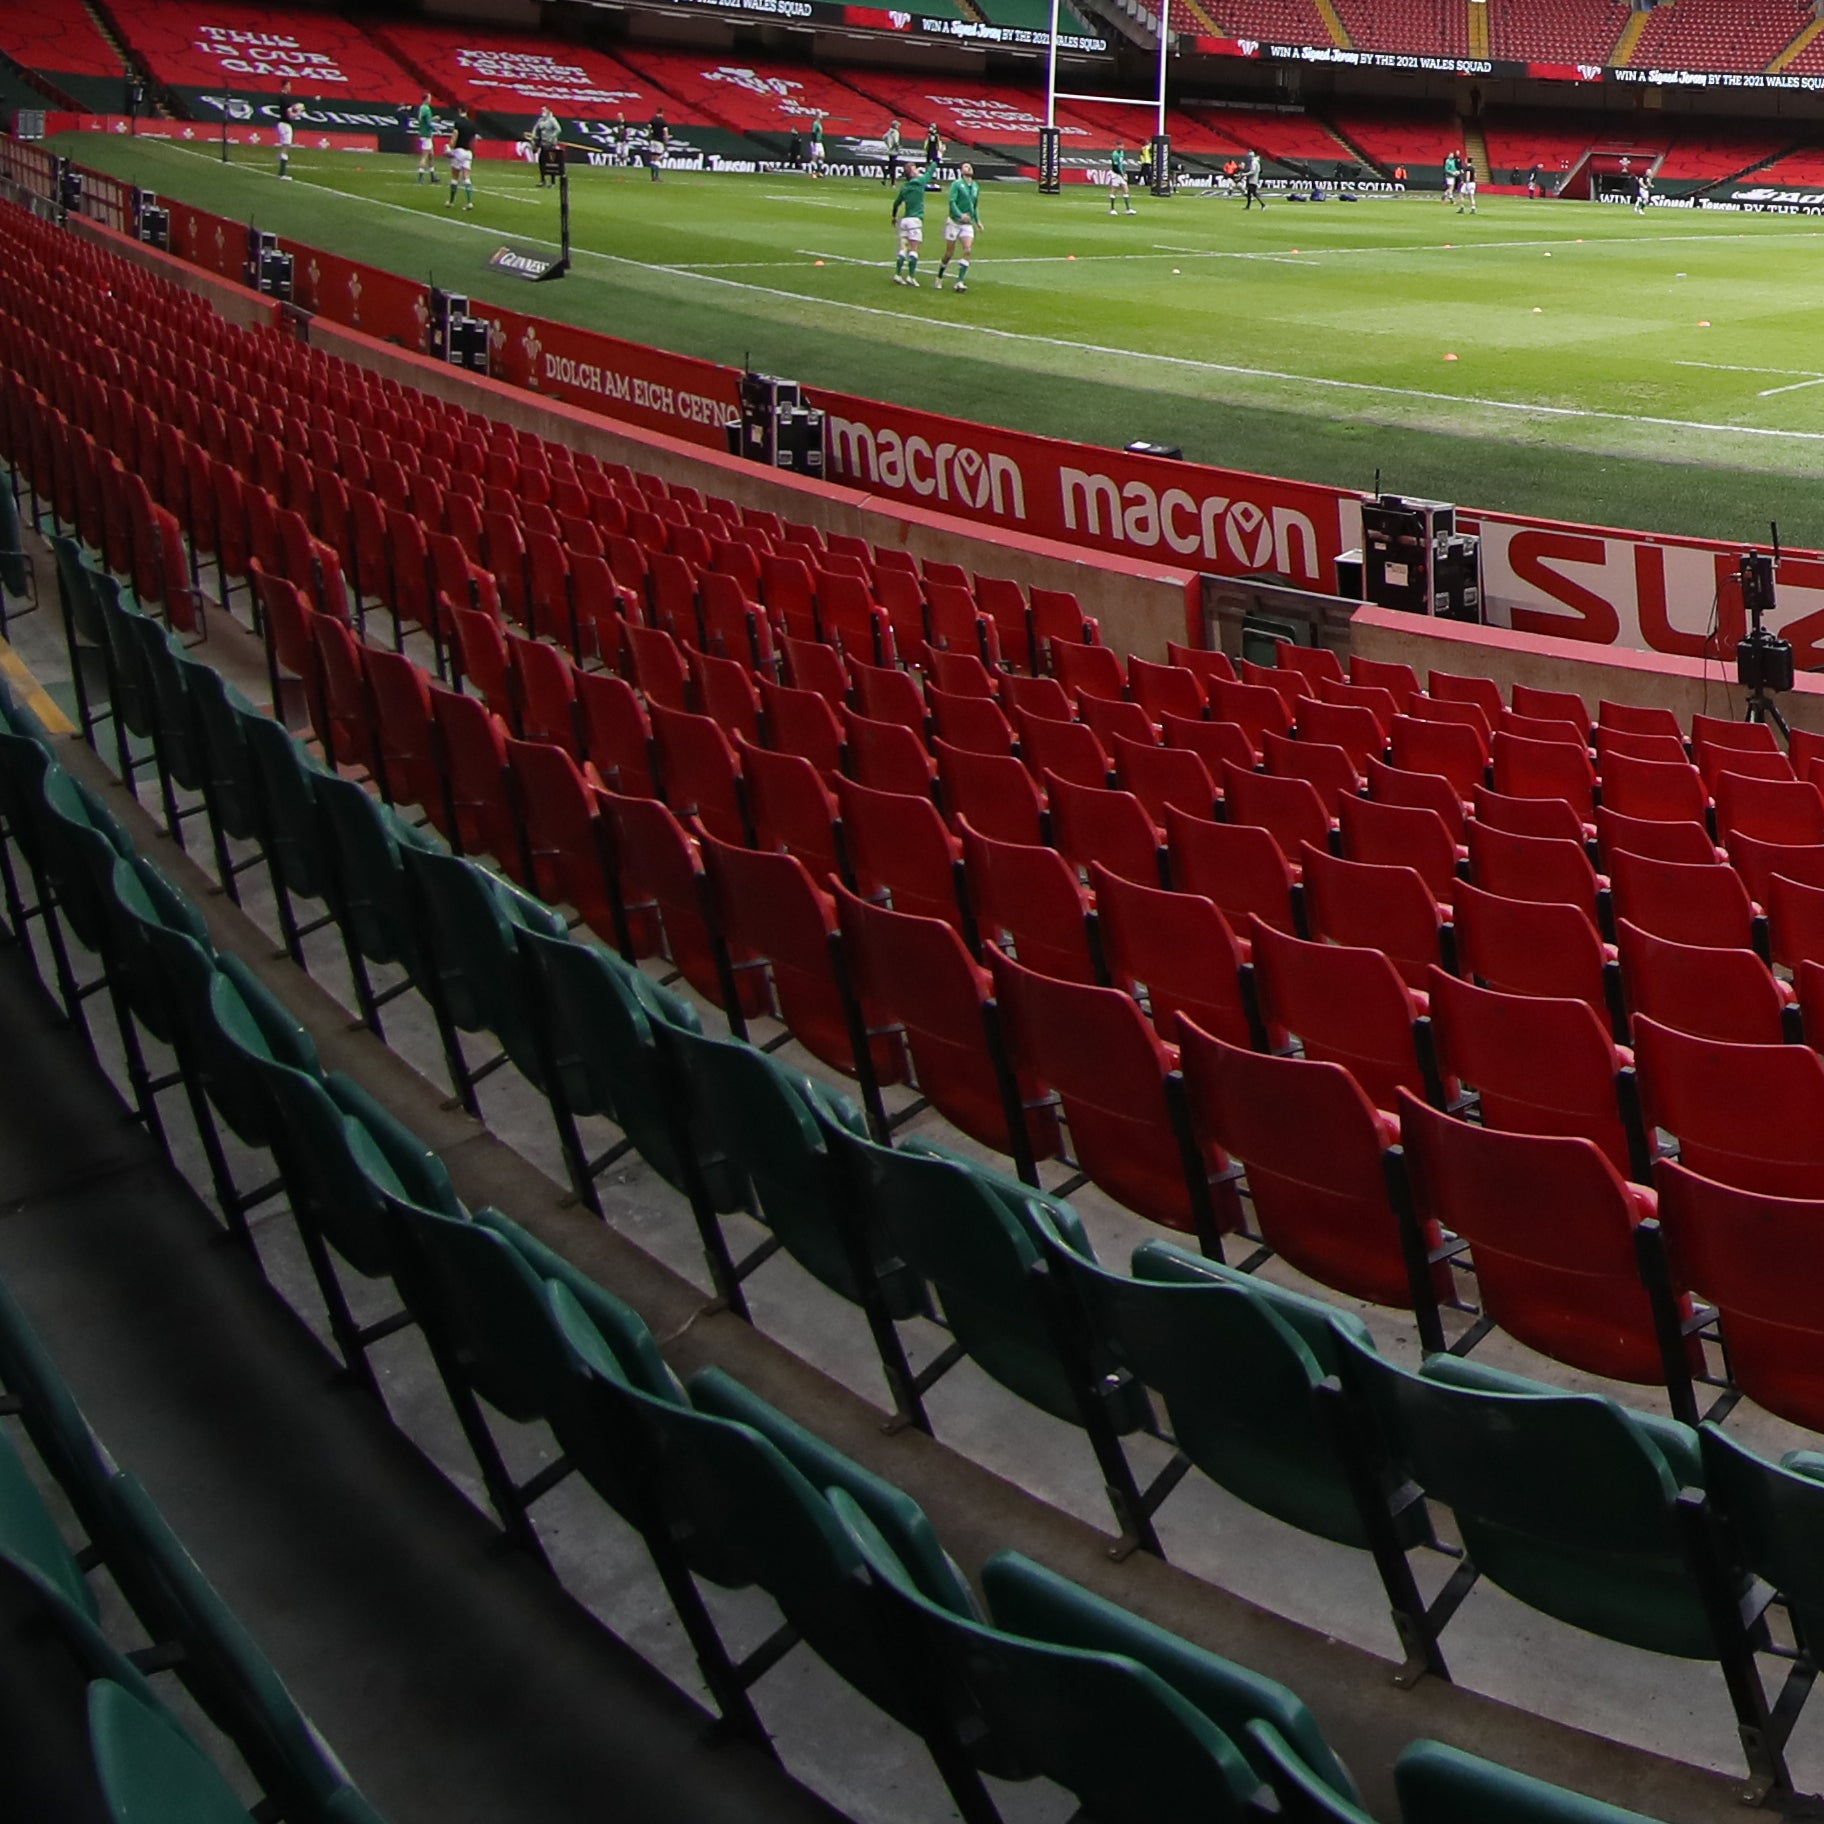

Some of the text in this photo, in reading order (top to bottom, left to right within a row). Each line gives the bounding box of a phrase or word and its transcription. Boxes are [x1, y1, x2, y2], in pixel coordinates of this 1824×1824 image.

[1615, 70, 1636, 80] WIN
[1638, 72, 1646, 81] A
[1648, 69, 1677, 85] Signed
[1678, 70, 1705, 86] Jersey
[1708, 70, 1720, 84] BY
[1723, 71, 1741, 85] THE
[1743, 72, 1764, 86] 2021
[1766, 72, 1799, 88] WALES
[1601, 193, 1631, 204] WIN
[1650, 194, 1695, 208] Signed
[545, 353, 603, 394] DIOLCH
[604, 372, 630, 401] AM
[633, 378, 674, 415] EICH
[830, 416, 1026, 520] macron
[1060, 466, 1320, 580] macron
